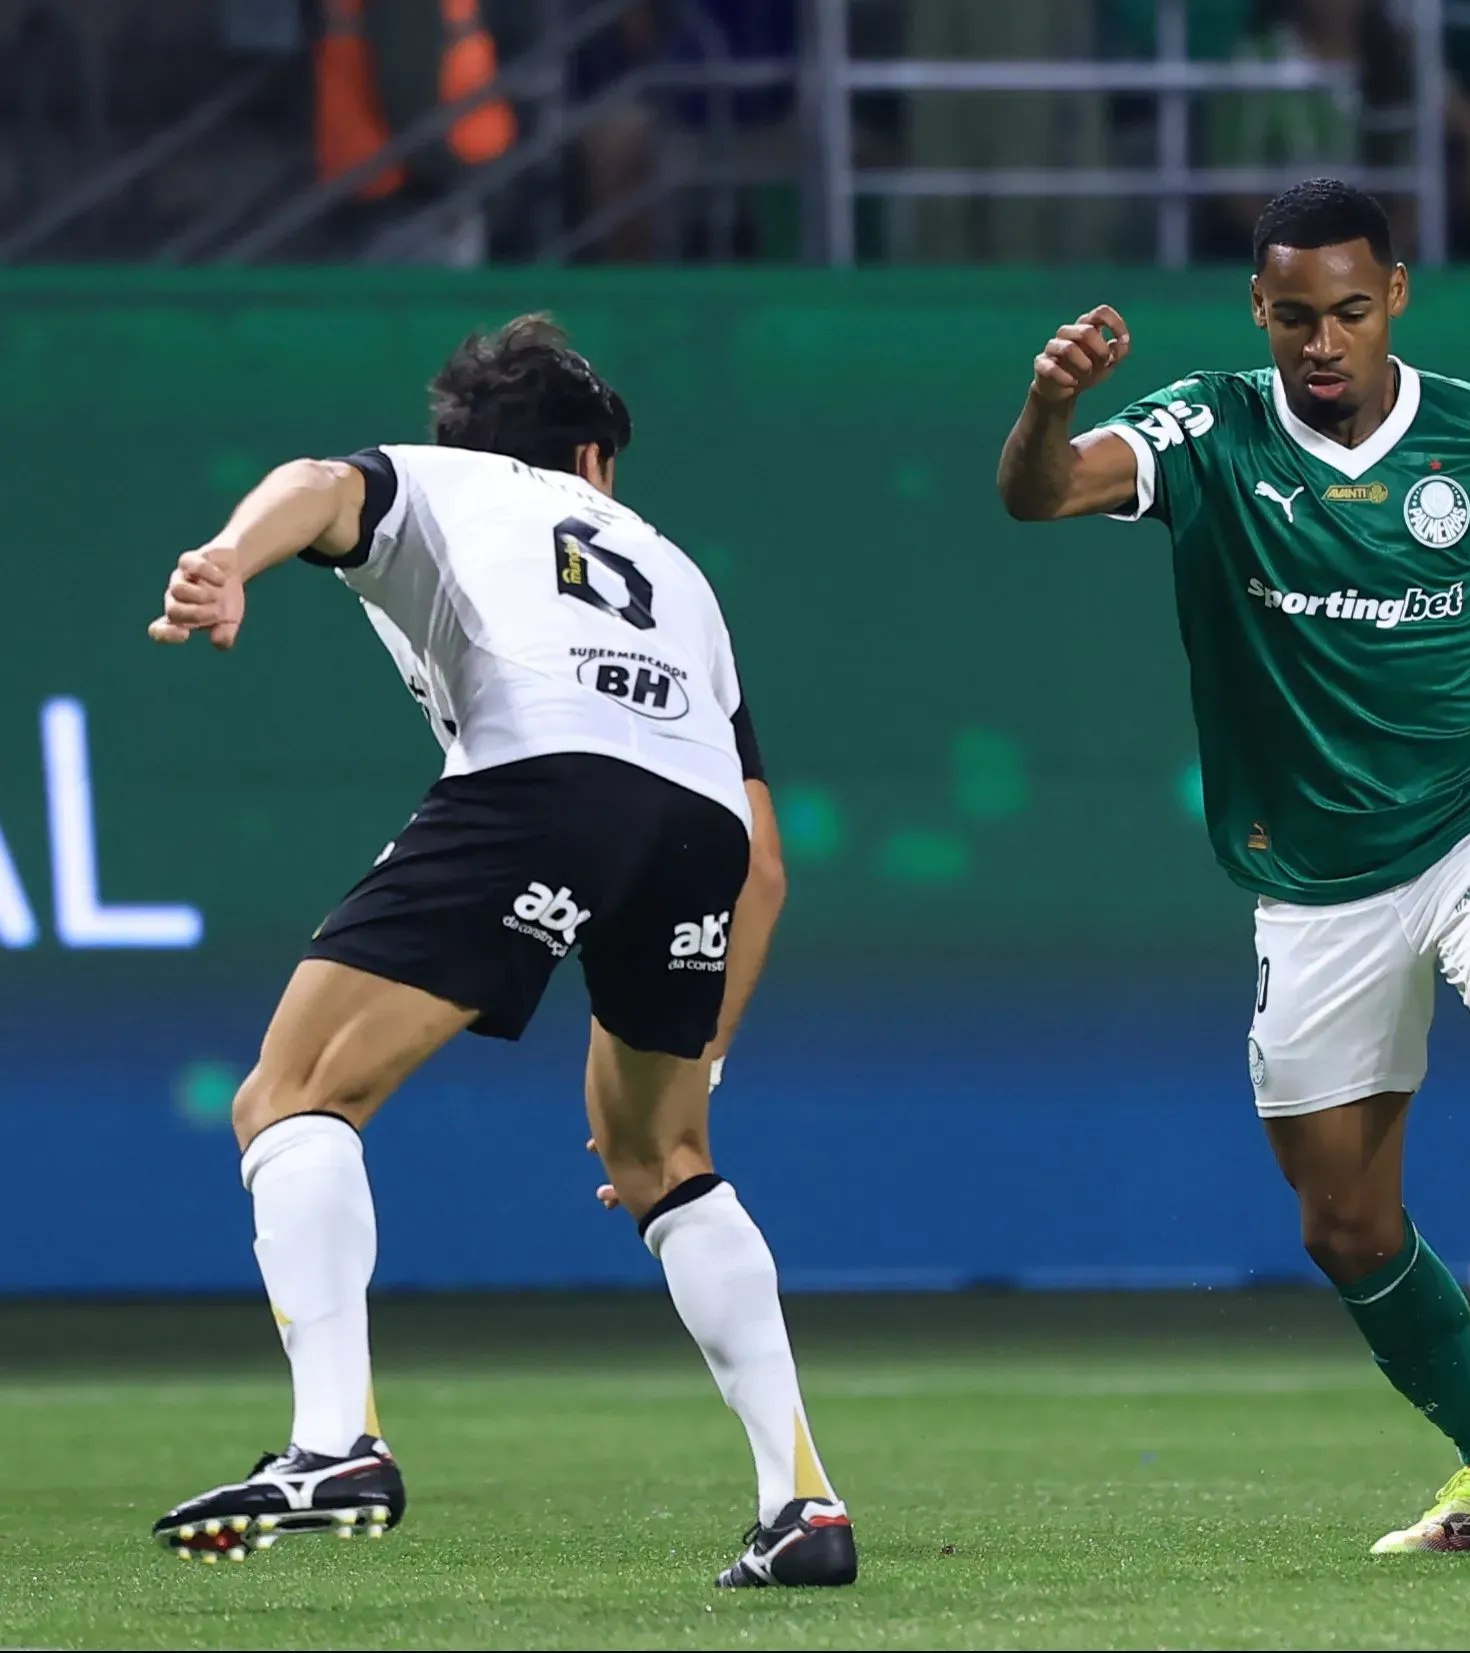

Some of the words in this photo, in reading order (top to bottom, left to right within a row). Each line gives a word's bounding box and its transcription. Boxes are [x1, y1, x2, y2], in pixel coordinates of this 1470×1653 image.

[1327, 487, 1367, 499] AVANTI
[1408, 506, 1467, 544] PALMEIRAS
[1247, 577, 1464, 629] sportingbet
[569, 647, 688, 681] SUPERMERCADOS
[596, 664, 670, 709] BH
[502, 915, 519, 930] da
[668, 959, 685, 971] da
[686, 959, 726, 972] const
